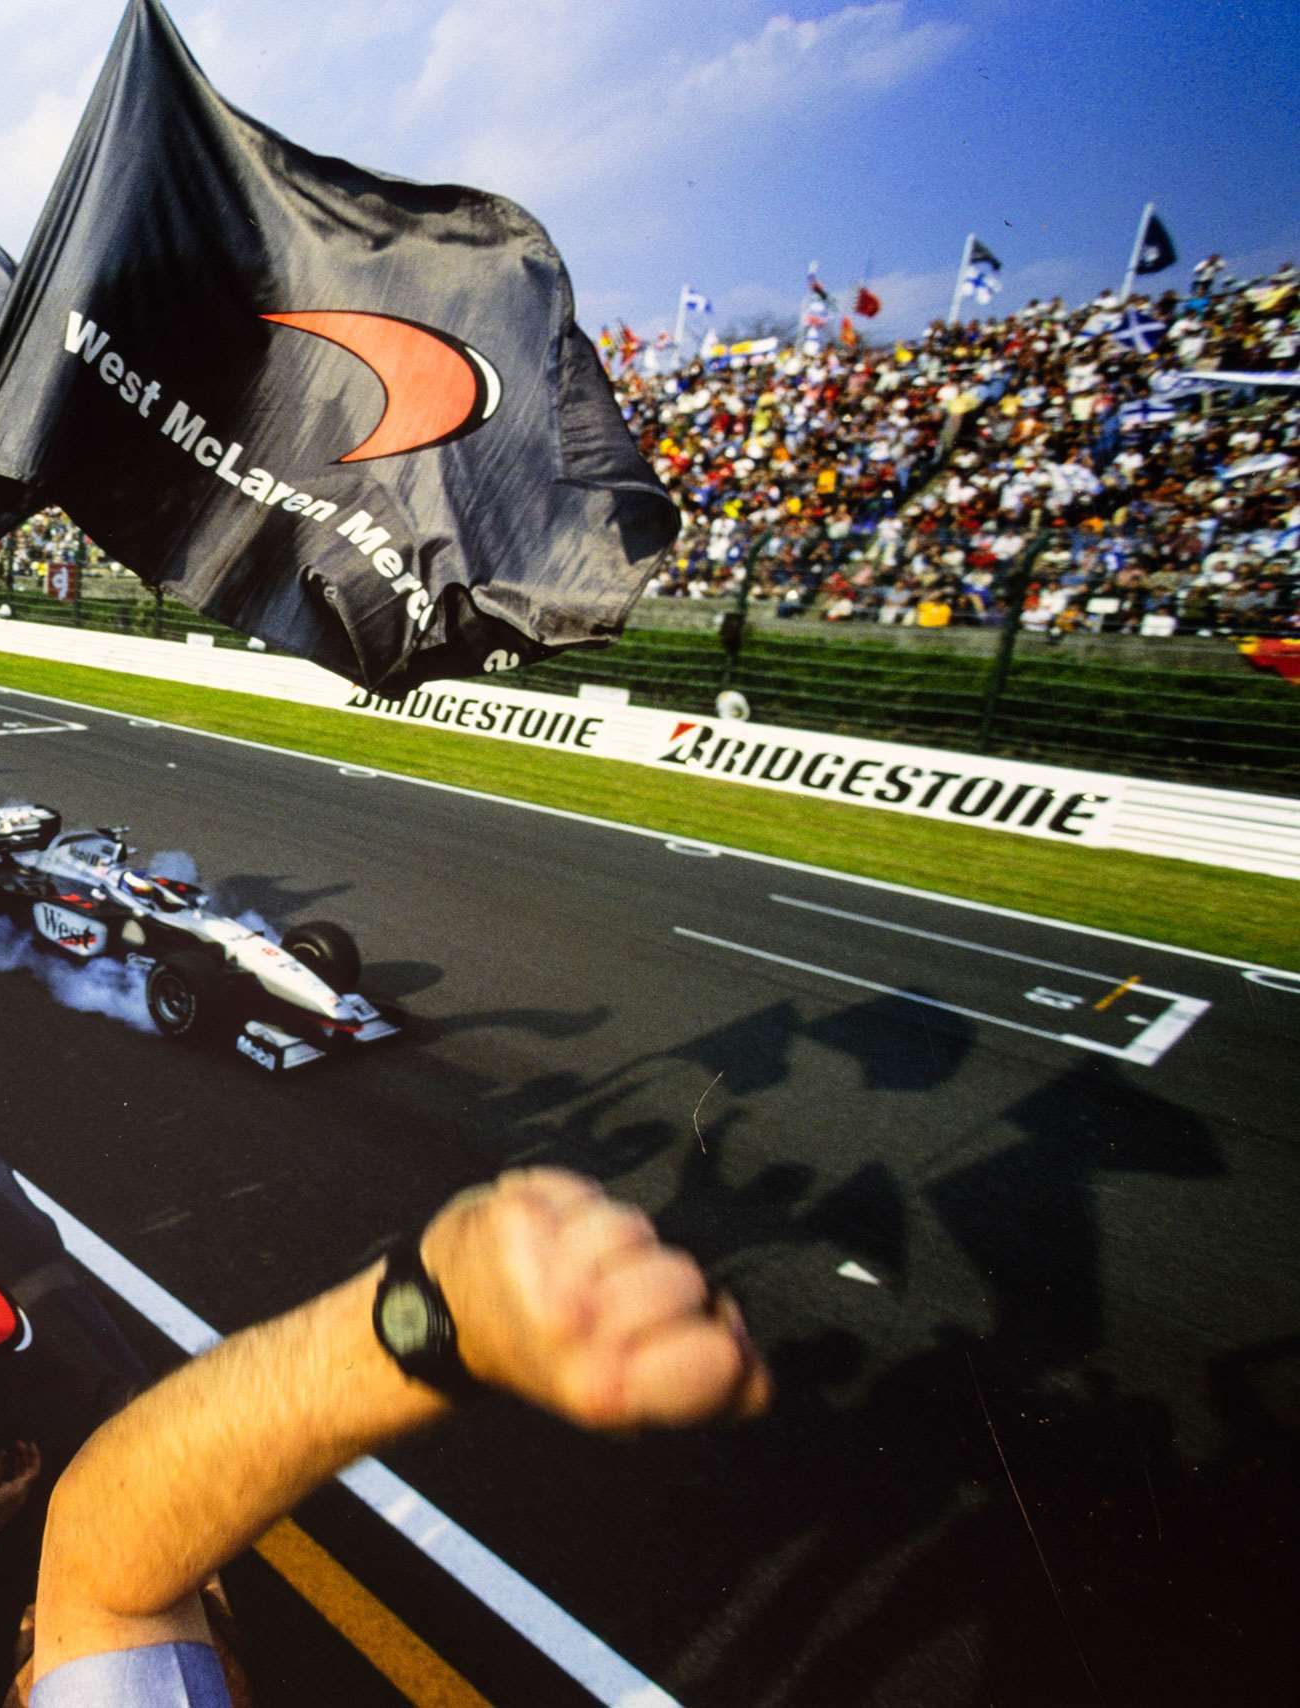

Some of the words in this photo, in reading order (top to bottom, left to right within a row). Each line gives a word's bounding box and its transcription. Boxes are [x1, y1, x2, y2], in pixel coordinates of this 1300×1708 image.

[64, 310, 162, 418] West
[160, 400, 338, 524] McLaren
[657, 722, 1109, 836] BRIDGESTONE
